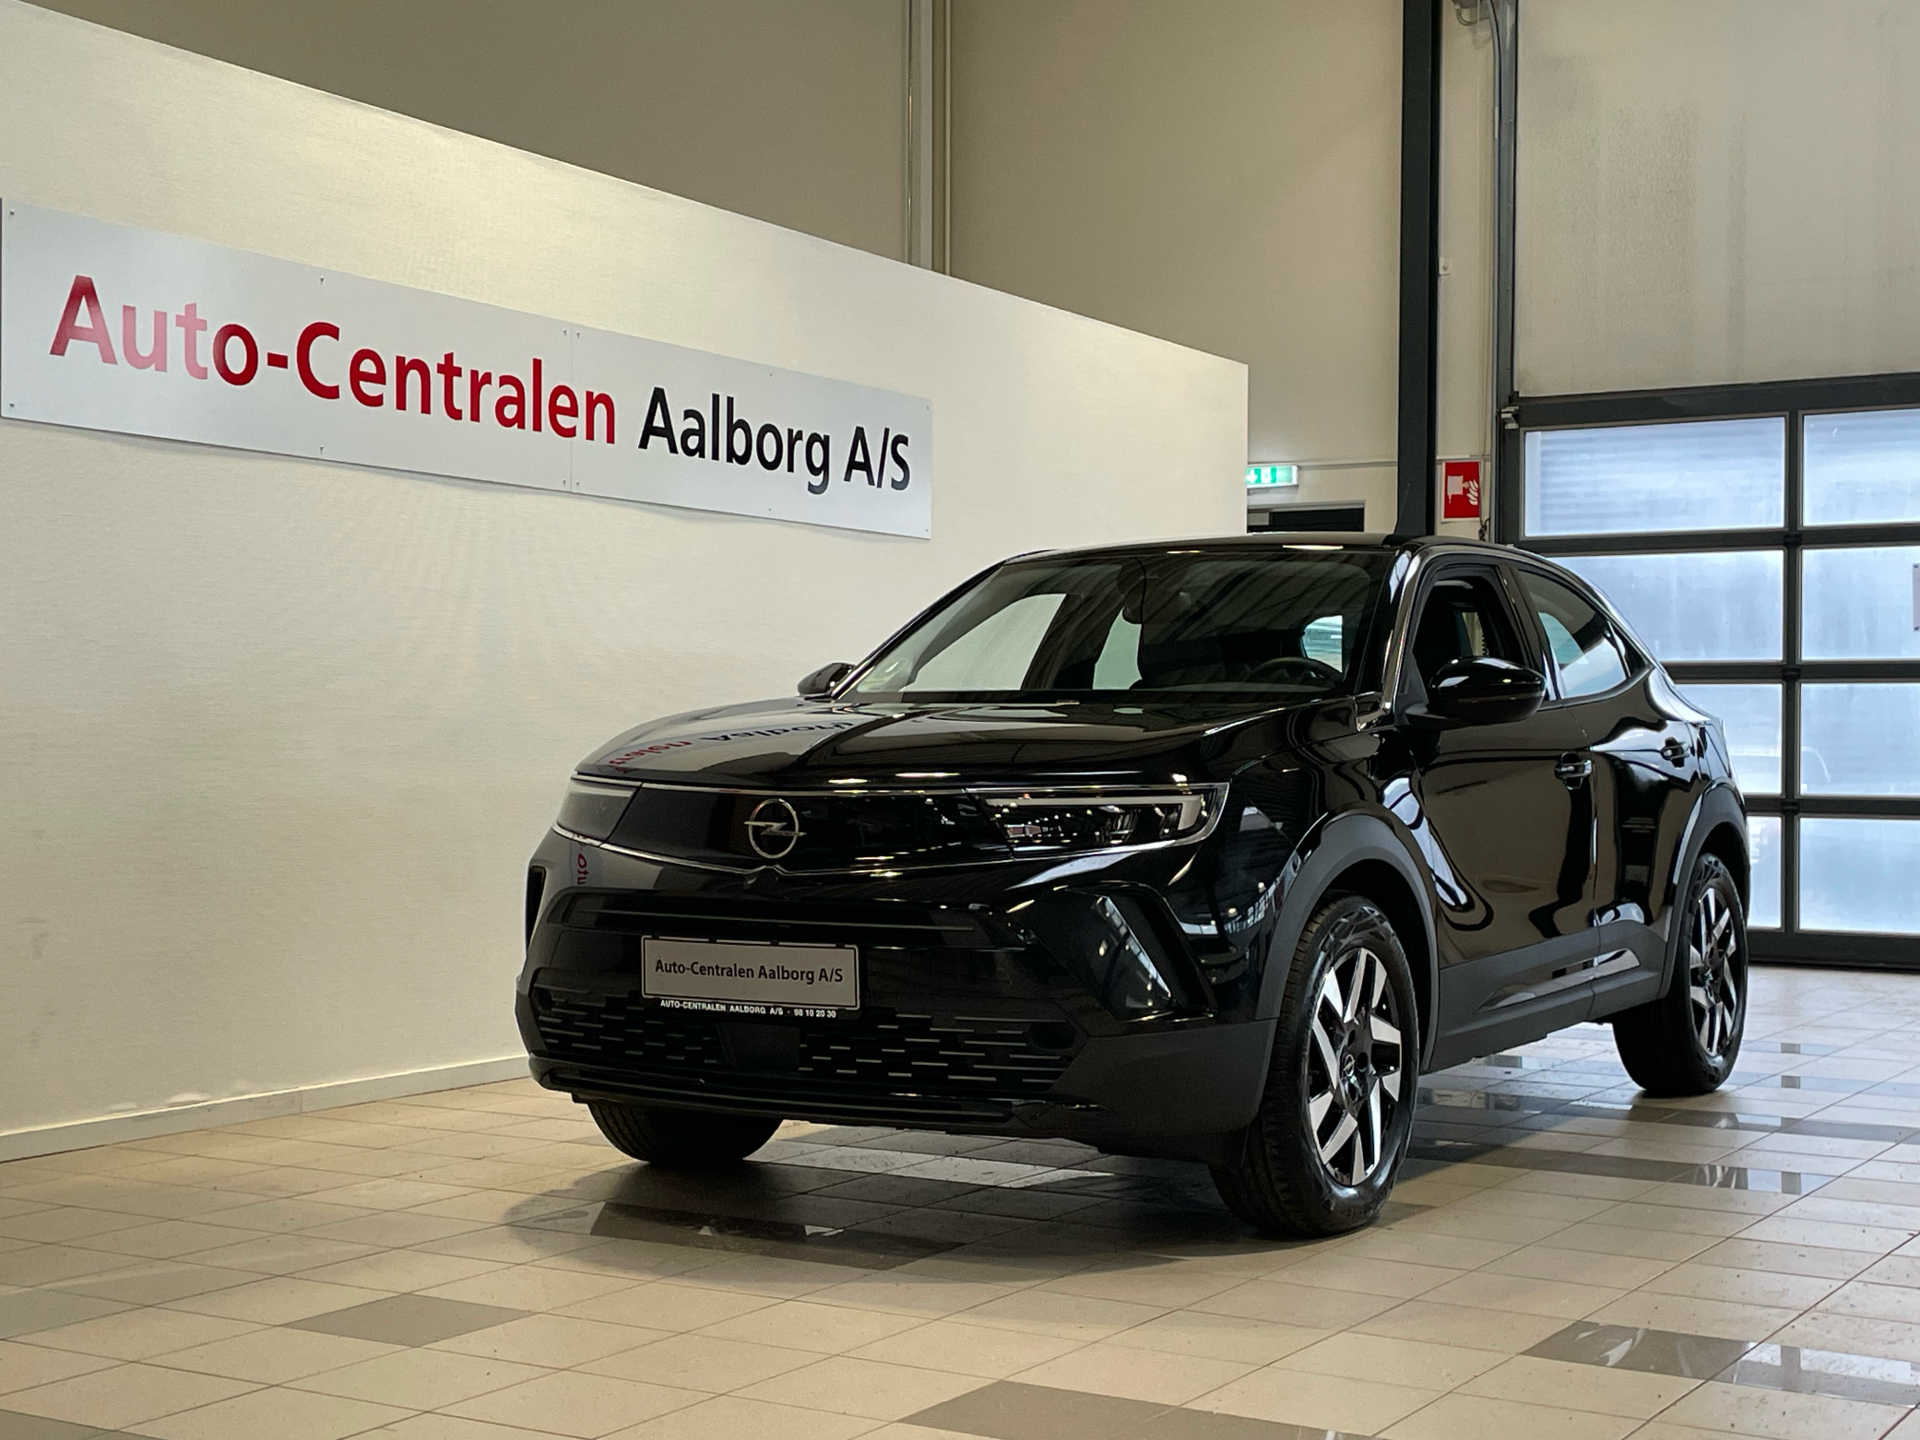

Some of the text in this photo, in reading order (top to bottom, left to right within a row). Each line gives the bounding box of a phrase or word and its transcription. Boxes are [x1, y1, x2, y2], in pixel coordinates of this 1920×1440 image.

[49, 274, 911, 496] Auto-Centralen Aalborg A/S
[655, 959, 844, 985] Auto-Centralen Aalborg A/S
[660, 999, 726, 1012] AUTO-CENTRALEN
[729, 1004, 766, 1014] AALBORG
[769, 1006, 784, 1016] A/S
[805, 1009, 815, 1018] 10
[815, 1010, 826, 1018] 20
[826, 1010, 837, 1019] 30
